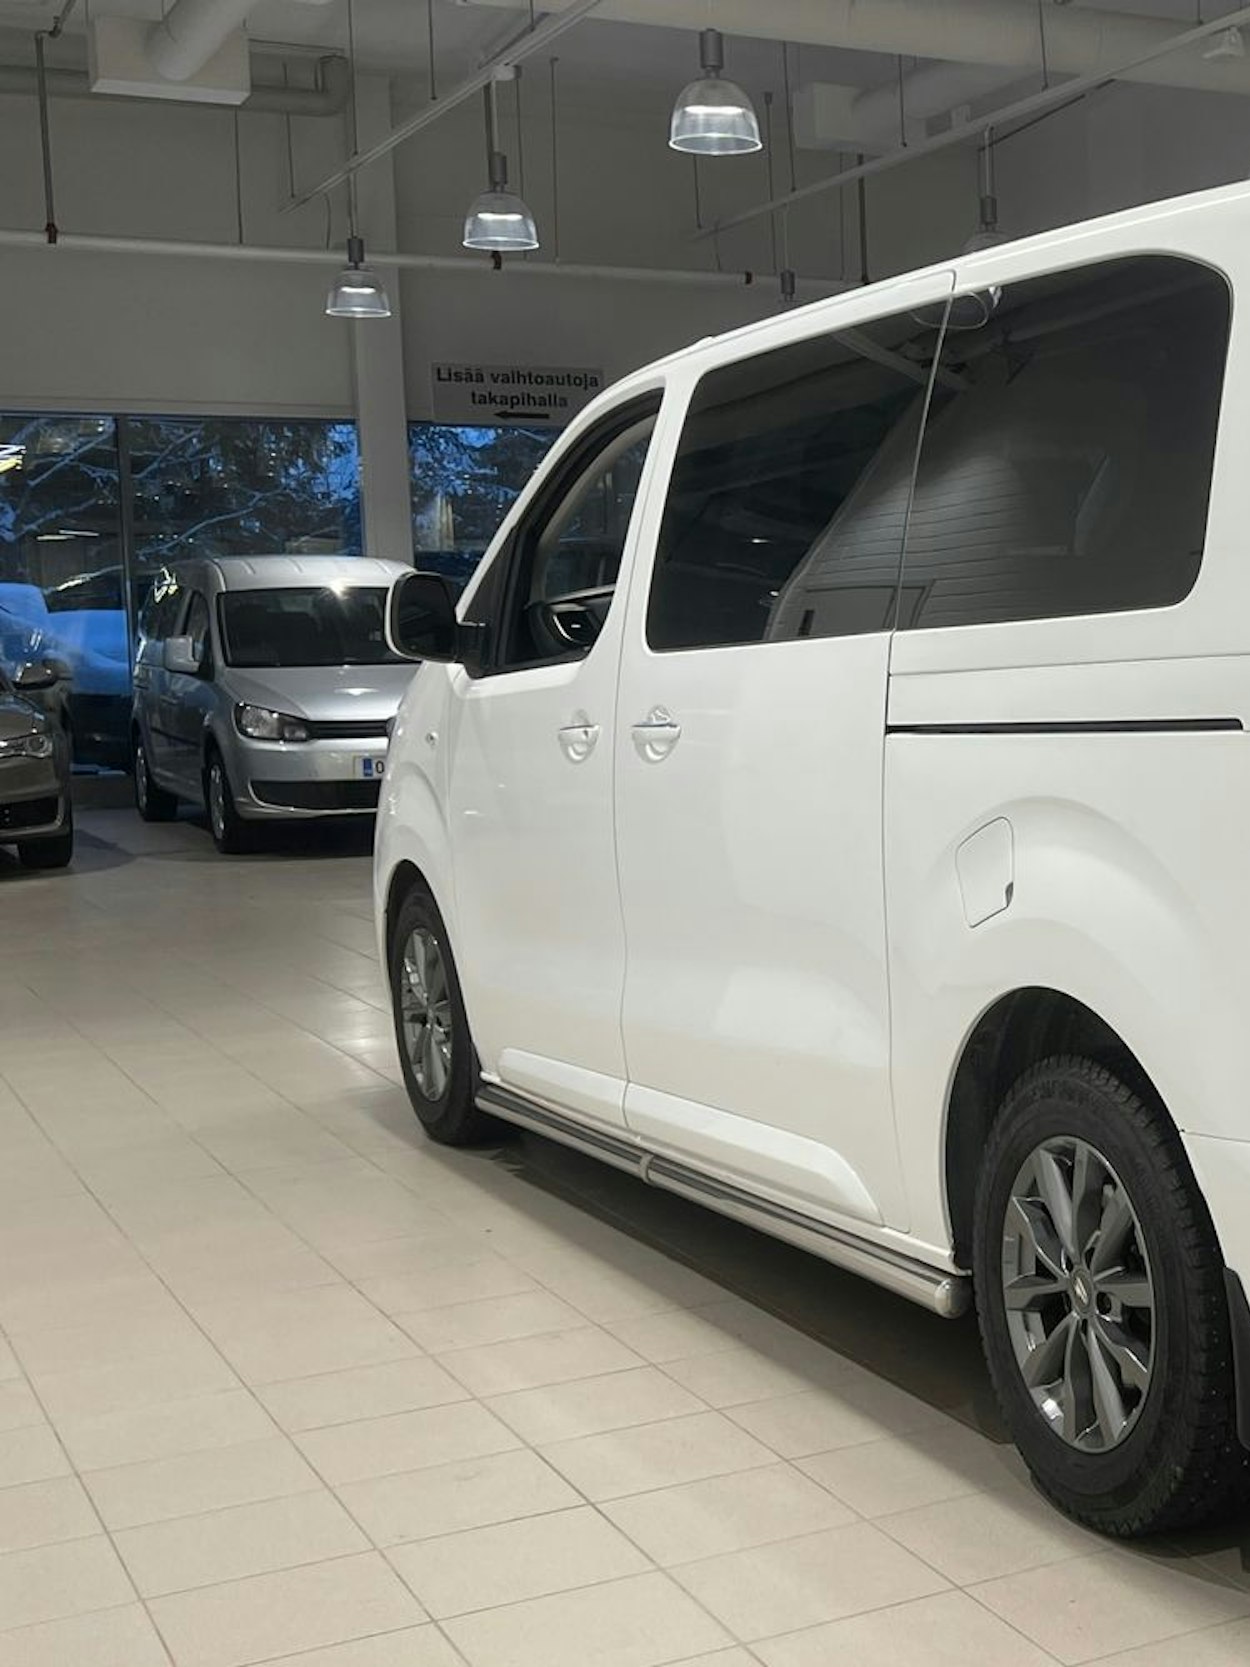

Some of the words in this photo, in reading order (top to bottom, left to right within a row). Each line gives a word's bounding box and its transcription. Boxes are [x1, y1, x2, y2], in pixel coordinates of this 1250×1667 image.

[436, 367, 485, 384] Lisää
[490, 369, 599, 391] vaihtoautoja
[471, 391, 568, 409] takapihalla
